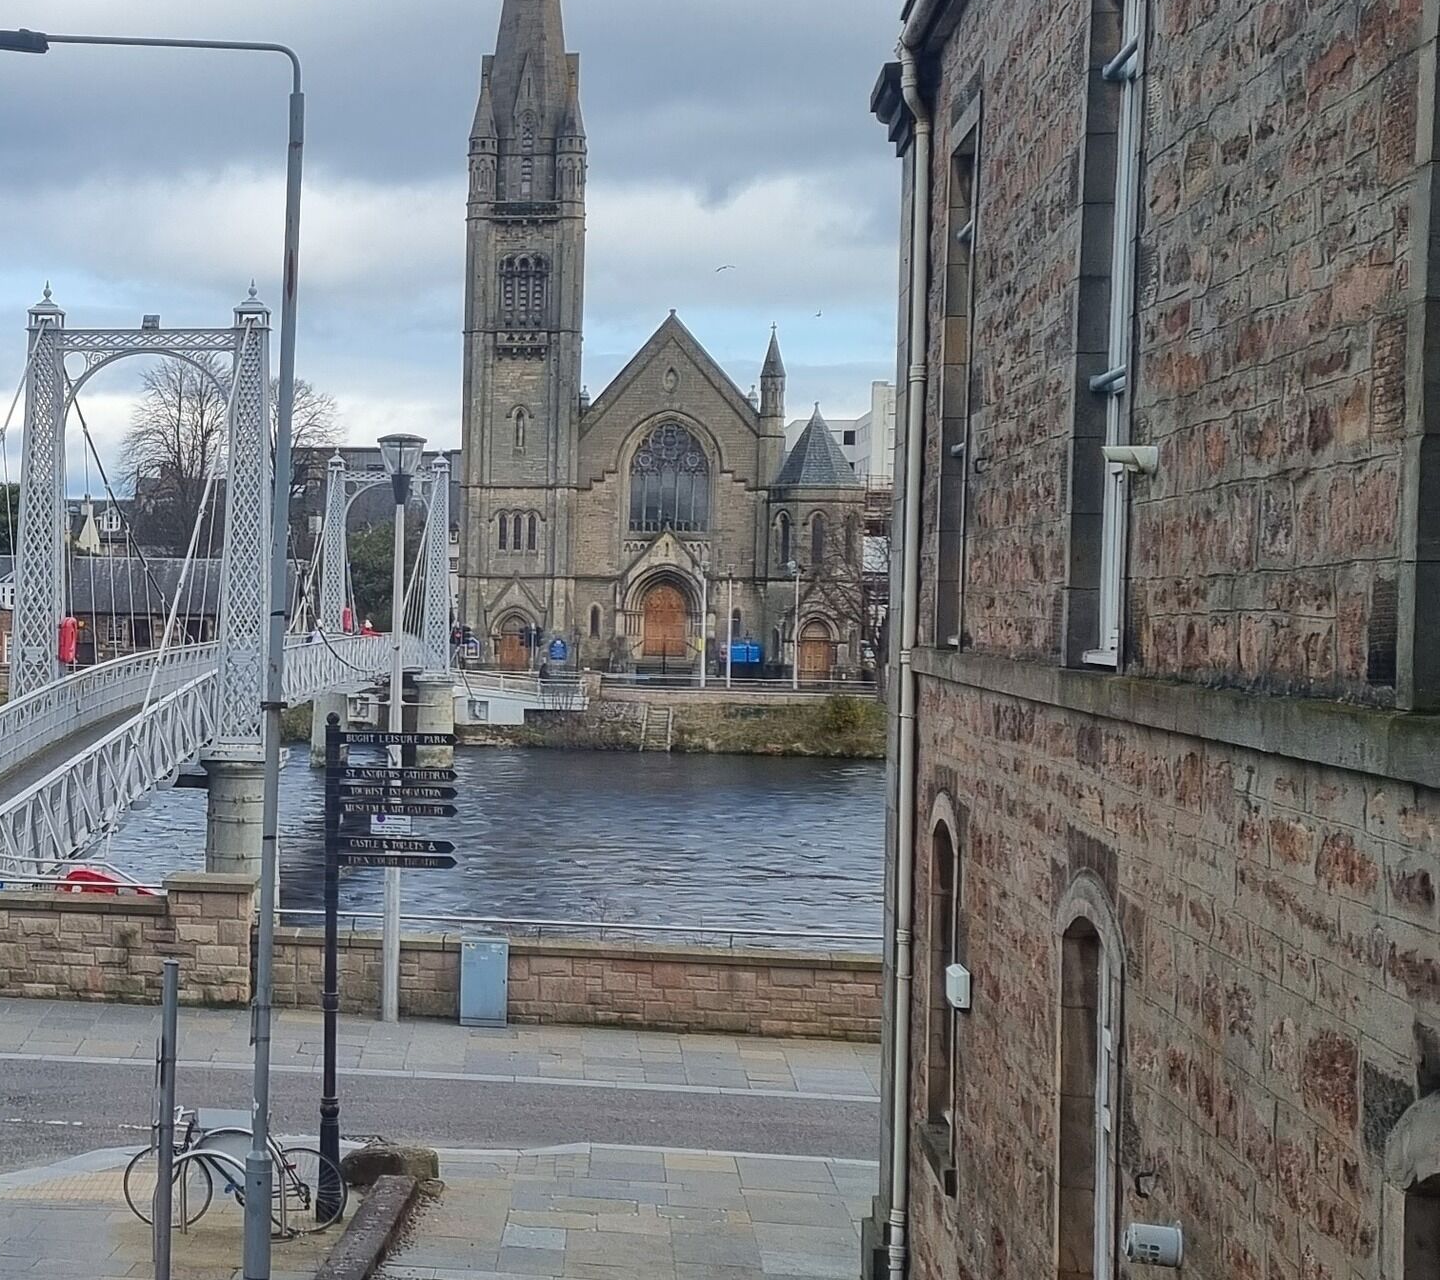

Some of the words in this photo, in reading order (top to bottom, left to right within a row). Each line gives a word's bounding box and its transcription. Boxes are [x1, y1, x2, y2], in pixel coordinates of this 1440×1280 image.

[346, 733, 374, 743] BUGHT
[379, 734, 419, 744] LEISURE
[424, 735, 448, 745] PARK
[404, 770, 450, 781] CATHEDRAL
[350, 839, 379, 849] CASTLE
[392, 840, 424, 851] TOILETS
